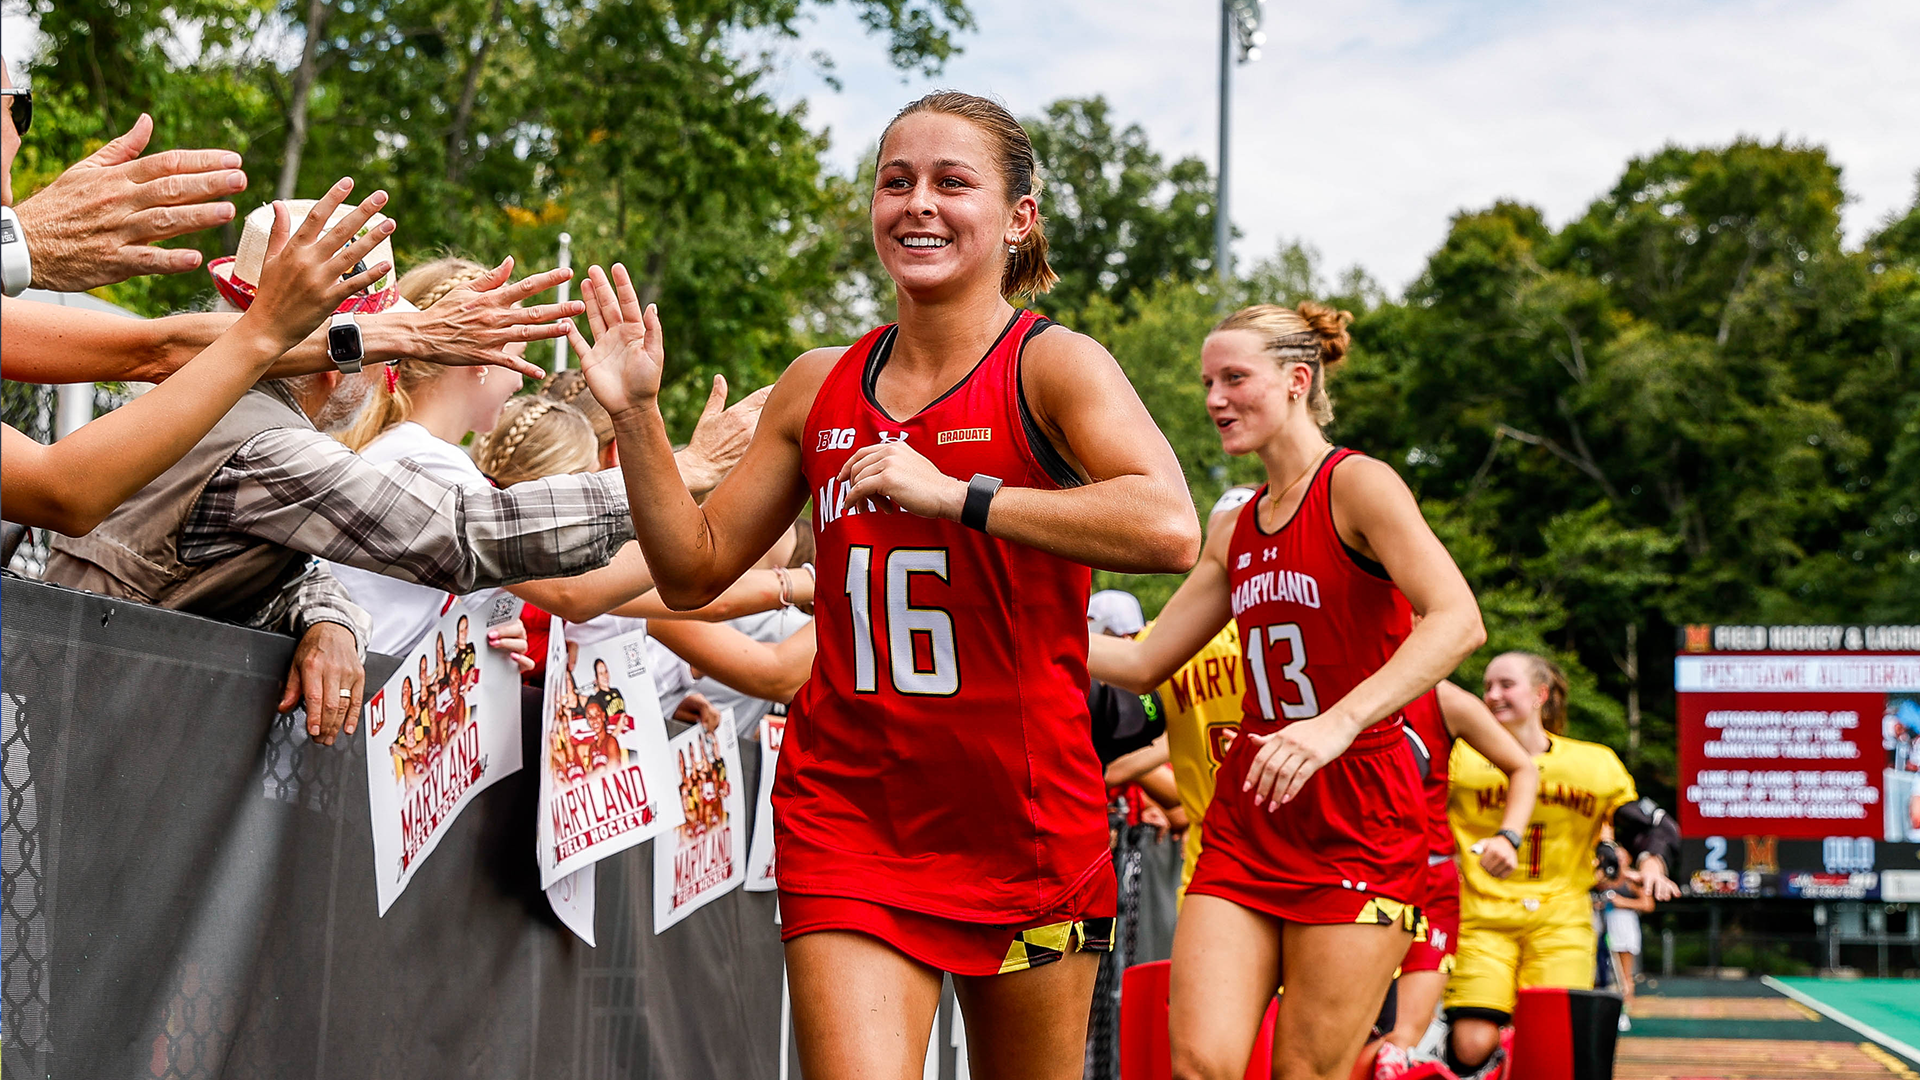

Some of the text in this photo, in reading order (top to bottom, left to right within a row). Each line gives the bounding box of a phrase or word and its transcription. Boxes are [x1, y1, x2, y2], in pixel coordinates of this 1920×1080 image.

[940, 429, 989, 443] GRADUATE
[1231, 570, 1321, 618] MARYLAND
[845, 544, 962, 697] 16
[1714, 625, 1768, 650] FIELD
[1768, 625, 1844, 650] HOCKEY
[1247, 622, 1320, 720] 13
[372, 697, 384, 731] M
[400, 721, 479, 854] MARYLAND
[550, 765, 648, 843] MARYLAND
[1477, 781, 1596, 817] MALAND
[559, 811, 644, 860] FIELD HOCKEY
[674, 827, 732, 892] MARYLAND
[1526, 823, 1546, 878] 1
[1705, 836, 1727, 871] 2
